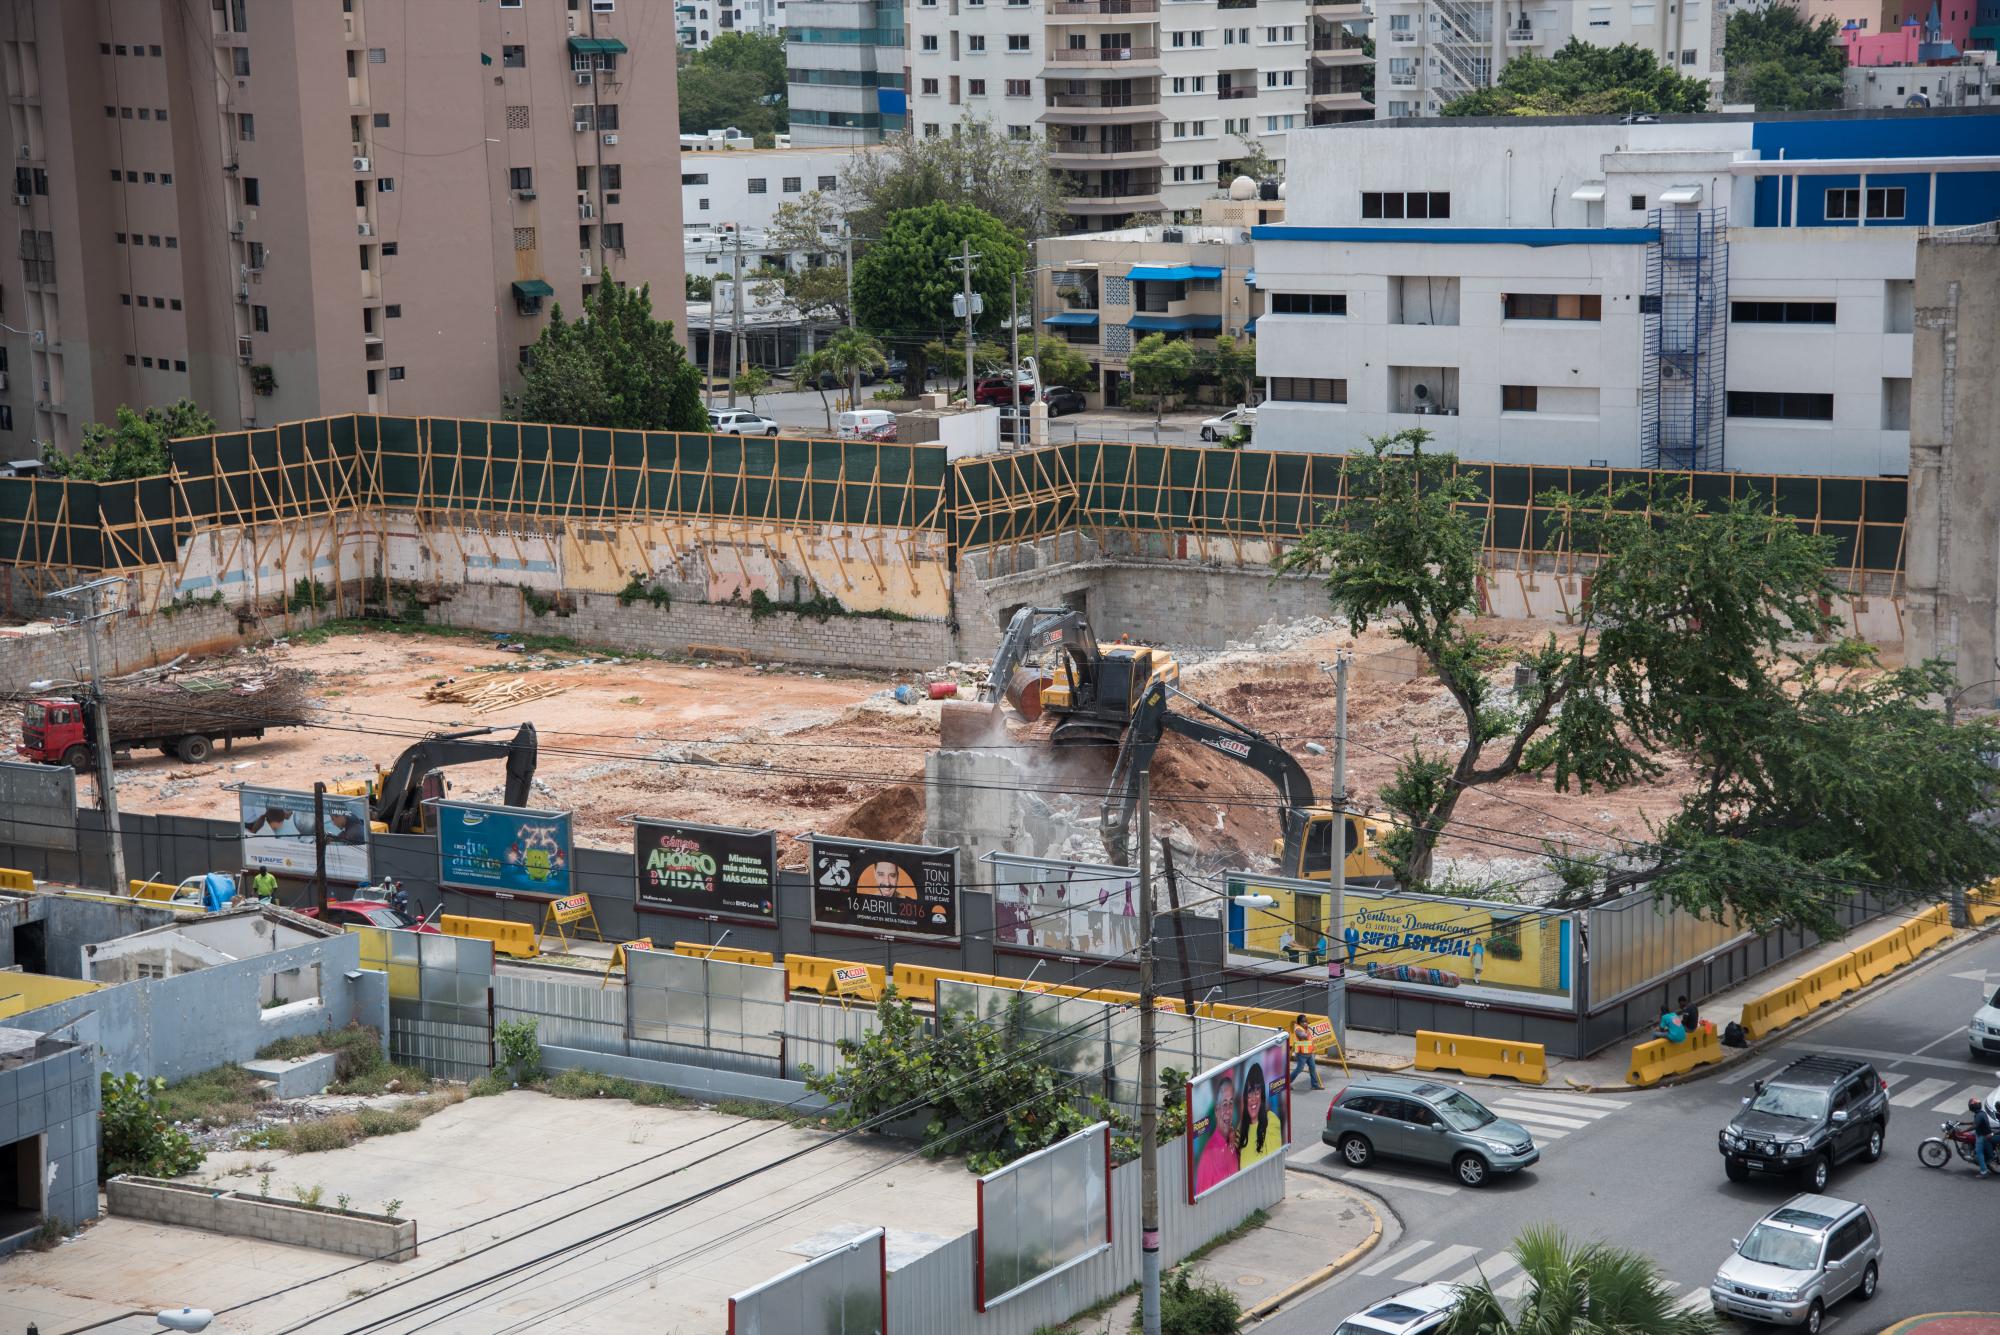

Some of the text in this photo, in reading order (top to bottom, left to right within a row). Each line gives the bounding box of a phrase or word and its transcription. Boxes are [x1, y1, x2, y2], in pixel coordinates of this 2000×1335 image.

[646, 848, 717, 876] AHORRO
[728, 854, 762, 865] Mientras
[722, 863, 769, 876] más ahorras,
[819, 857, 851, 887] 25
[923, 868, 949, 882] TONI
[657, 869, 706, 891] VIDA
[722, 873, 740, 884] MÁS
[741, 875, 768, 885] GANAS
[924, 881, 950, 896] RIOS
[555, 896, 588, 911] EXCON
[748, 901, 759, 909] León
[848, 897, 925, 919] 16 ABRIL 2016
[1356, 907, 1473, 935] Sentirse Dominicano
[1361, 931, 1471, 957] SUPER ESPECIAL
[837, 967, 867, 980] EXCON
[1308, 1022, 1331, 1036] XCON
